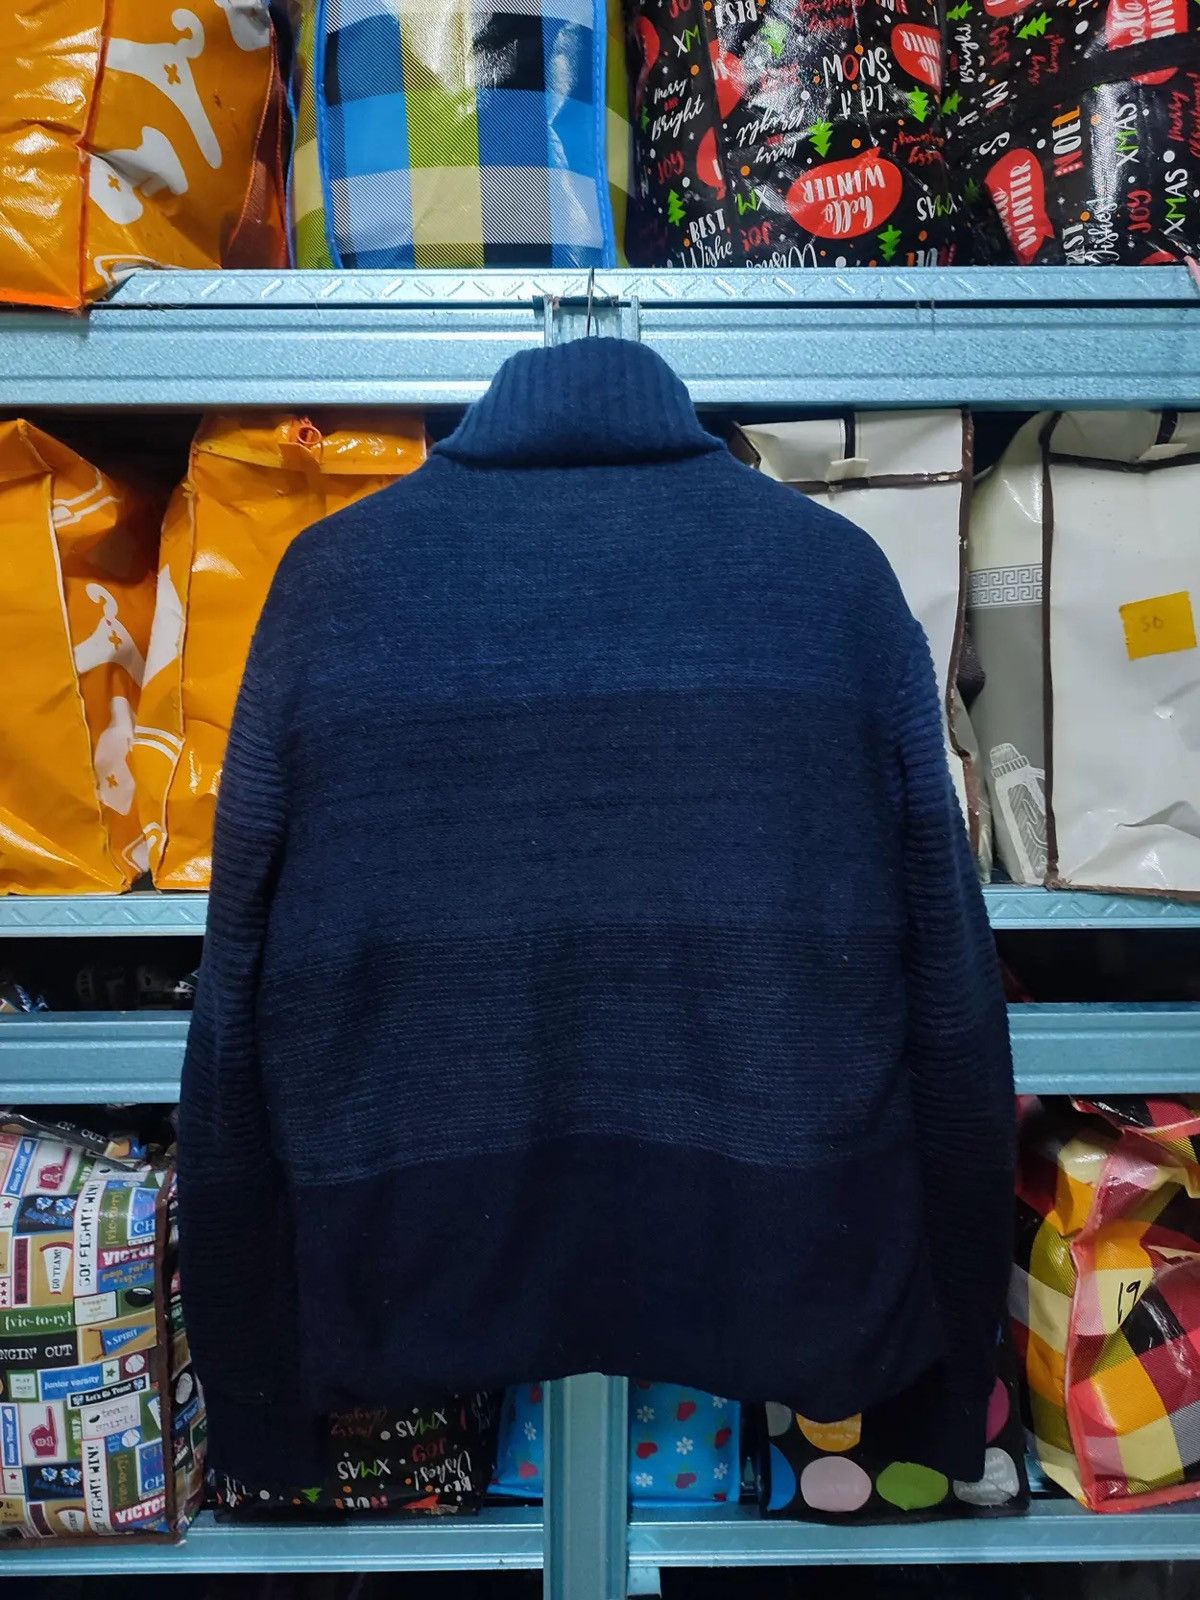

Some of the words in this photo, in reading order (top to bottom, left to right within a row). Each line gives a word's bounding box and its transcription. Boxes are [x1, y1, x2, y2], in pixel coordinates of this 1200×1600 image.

[1051, 105, 1084, 178] NOEL
[1114, 102, 1140, 168] XMAS
[801, 164, 886, 203] WINTER
[1009, 158, 1038, 251] WINTER
[1162, 167, 1189, 236] XMAS
[687, 207, 727, 244] BEST
[1116, 1279, 1141, 1325] 19
[44, 1343, 73, 1358] OUT
[336, 1457, 393, 1481] XMAS
